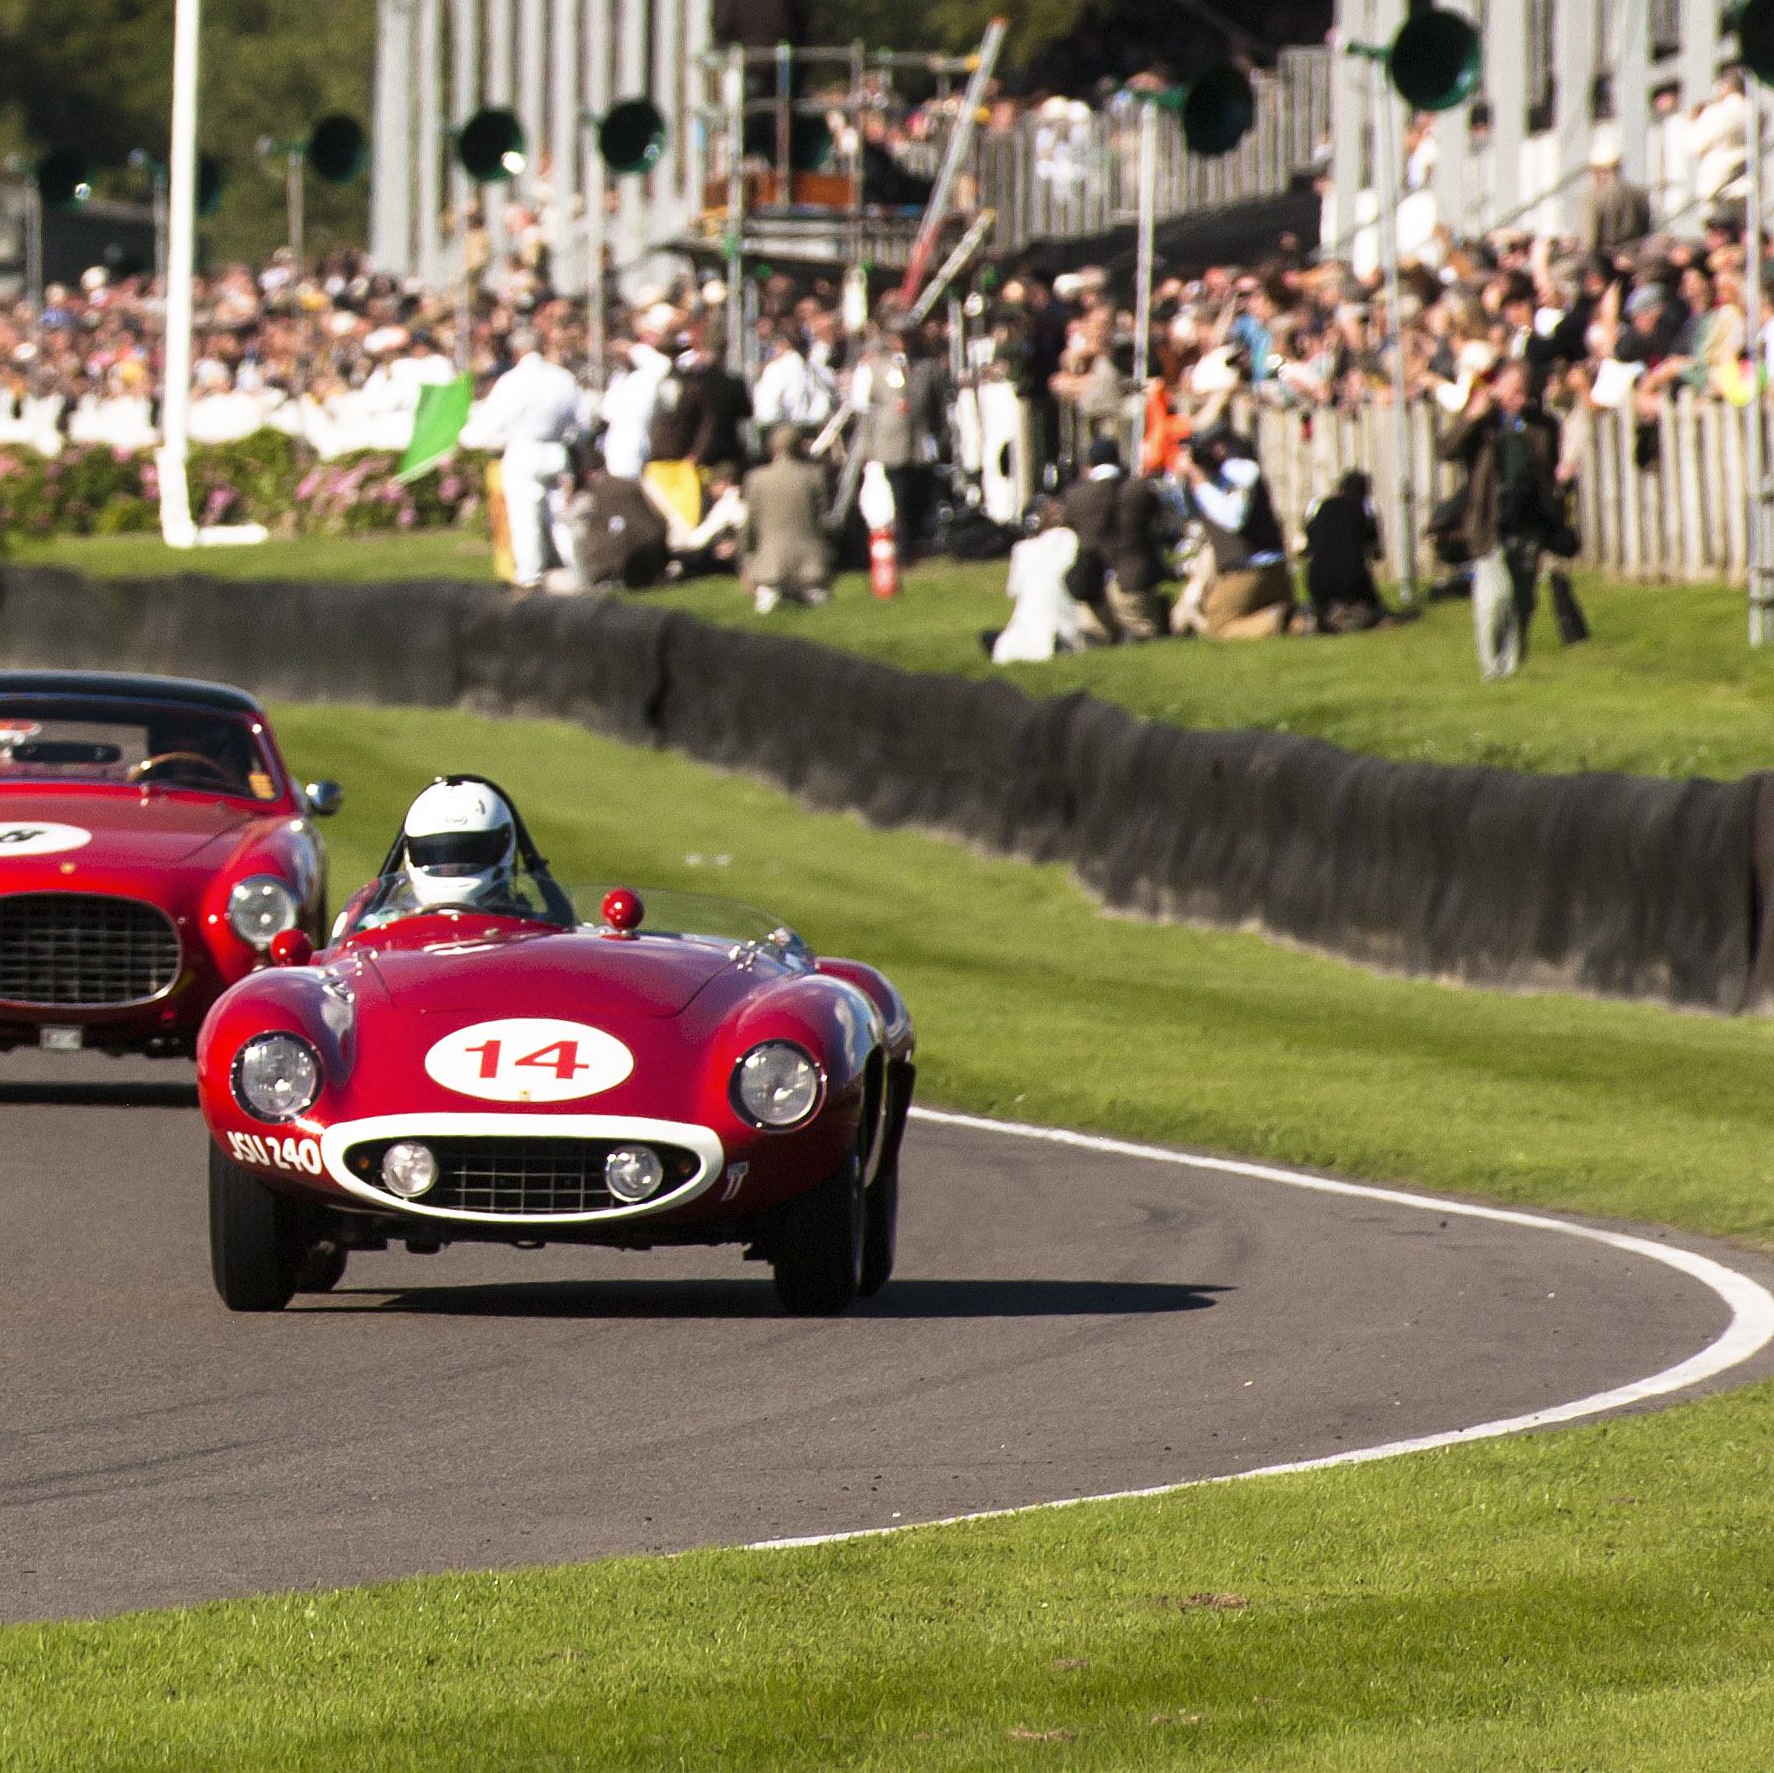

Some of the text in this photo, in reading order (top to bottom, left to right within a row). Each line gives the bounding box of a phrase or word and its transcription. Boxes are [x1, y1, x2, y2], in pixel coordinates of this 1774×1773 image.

[465, 1039, 590, 1080] 14
[227, 1131, 323, 1175] JSU 240
